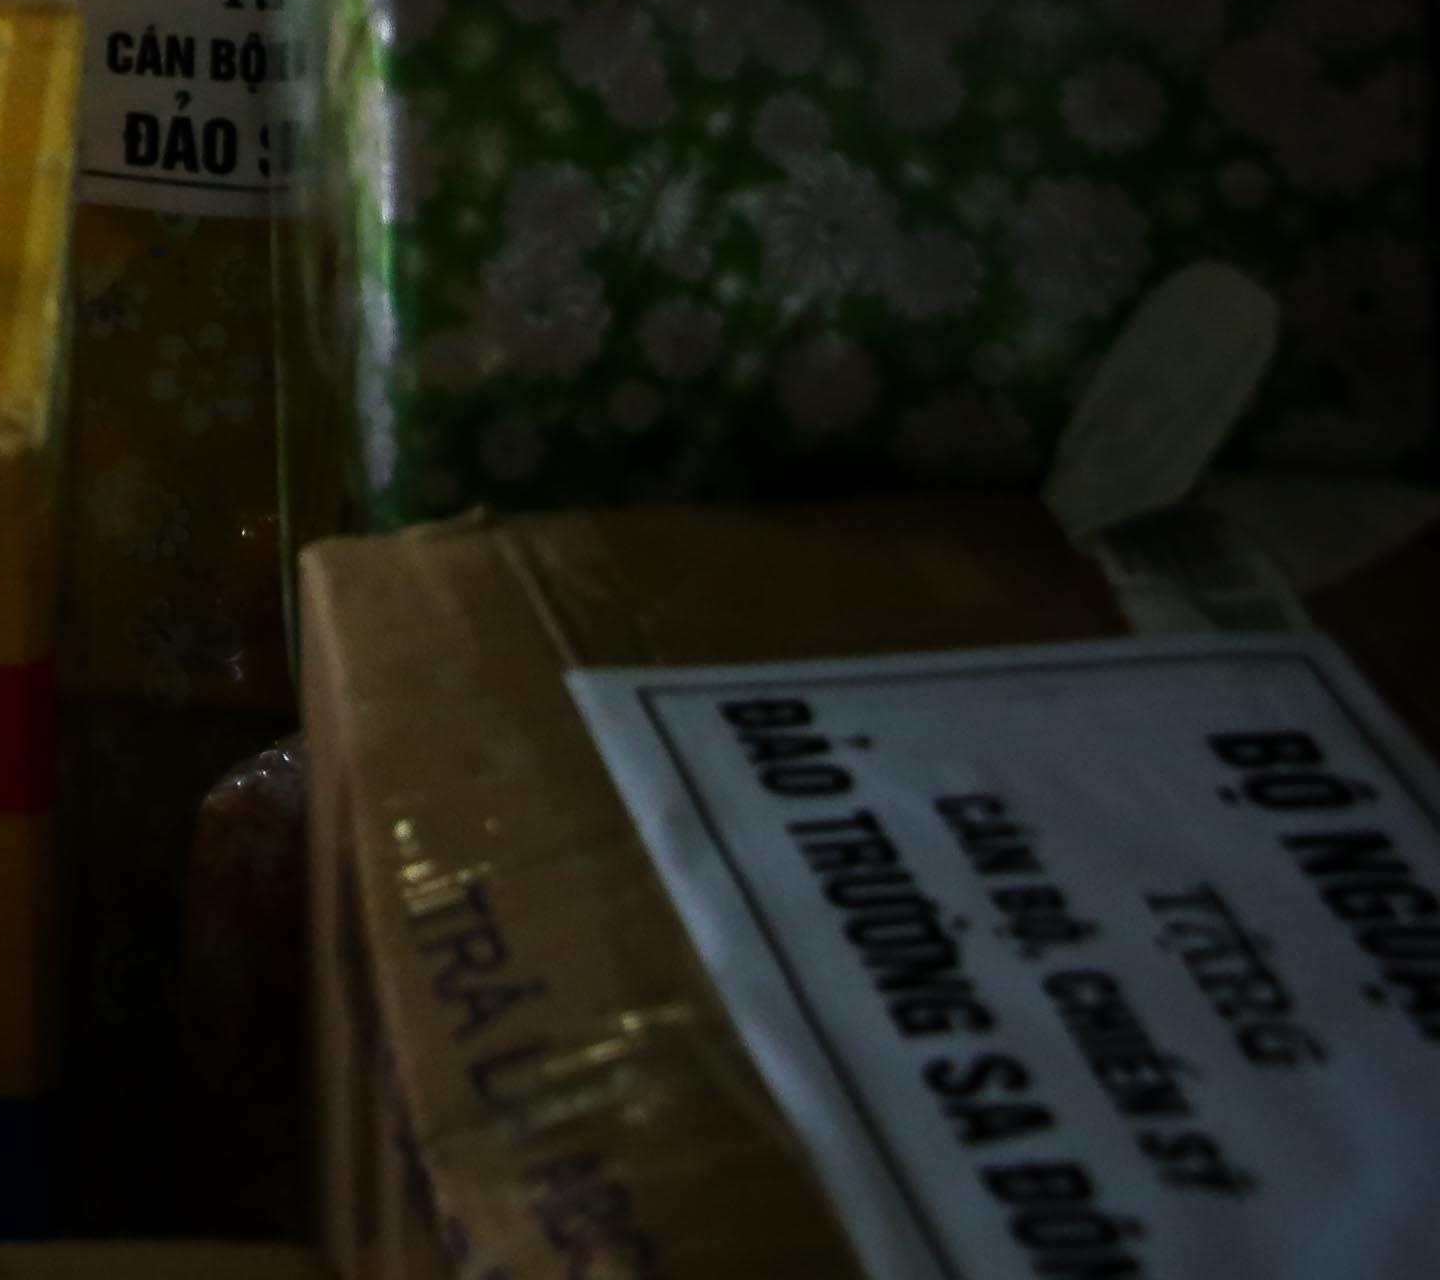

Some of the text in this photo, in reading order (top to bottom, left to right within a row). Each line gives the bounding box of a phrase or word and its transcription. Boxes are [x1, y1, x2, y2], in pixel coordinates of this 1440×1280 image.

[106, 24, 196, 79] CÁN
[123, 90, 239, 176] ĐẢO
[1205, 728, 1382, 812] BỘ
[718, 696, 1144, 1280] ĐẢO TRƯỜNG SA ĐÔN
[932, 790, 1039, 881] CÁN
[1040, 966, 1193, 1121] CHIẾN
[1136, 1126, 1261, 1200] SỸ
